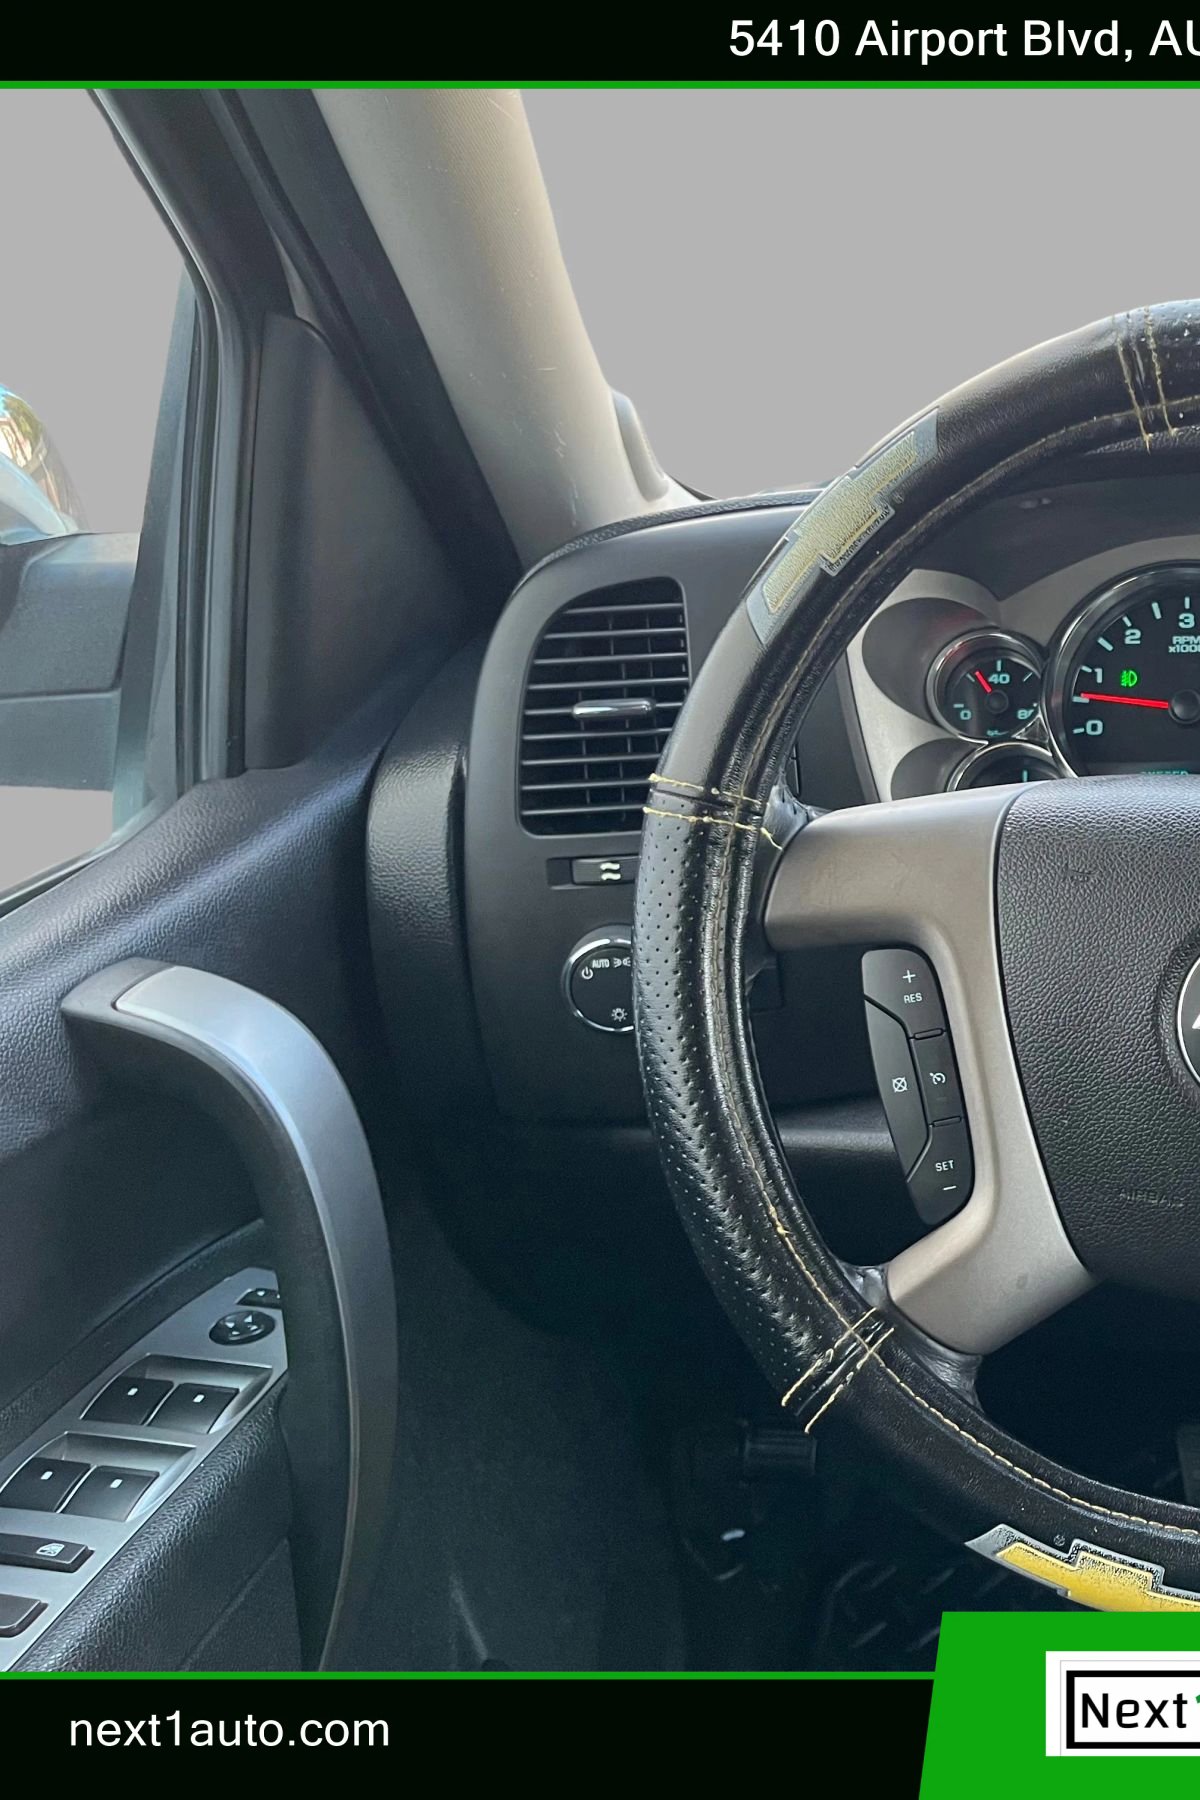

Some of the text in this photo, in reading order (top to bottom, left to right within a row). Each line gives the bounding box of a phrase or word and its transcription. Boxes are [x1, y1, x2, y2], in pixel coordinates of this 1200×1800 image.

[1178, 613, 1195, 629] 3
[1124, 629, 1142, 645] 2
[988, 673, 1010, 684] 40
[1094, 667, 1104, 684] 1
[960, 709, 972, 720] 0
[1085, 720, 1104, 736] 0
[592, 958, 610, 969] AUTO
[903, 992, 923, 1004] RES
[935, 1159, 955, 1172] SET
